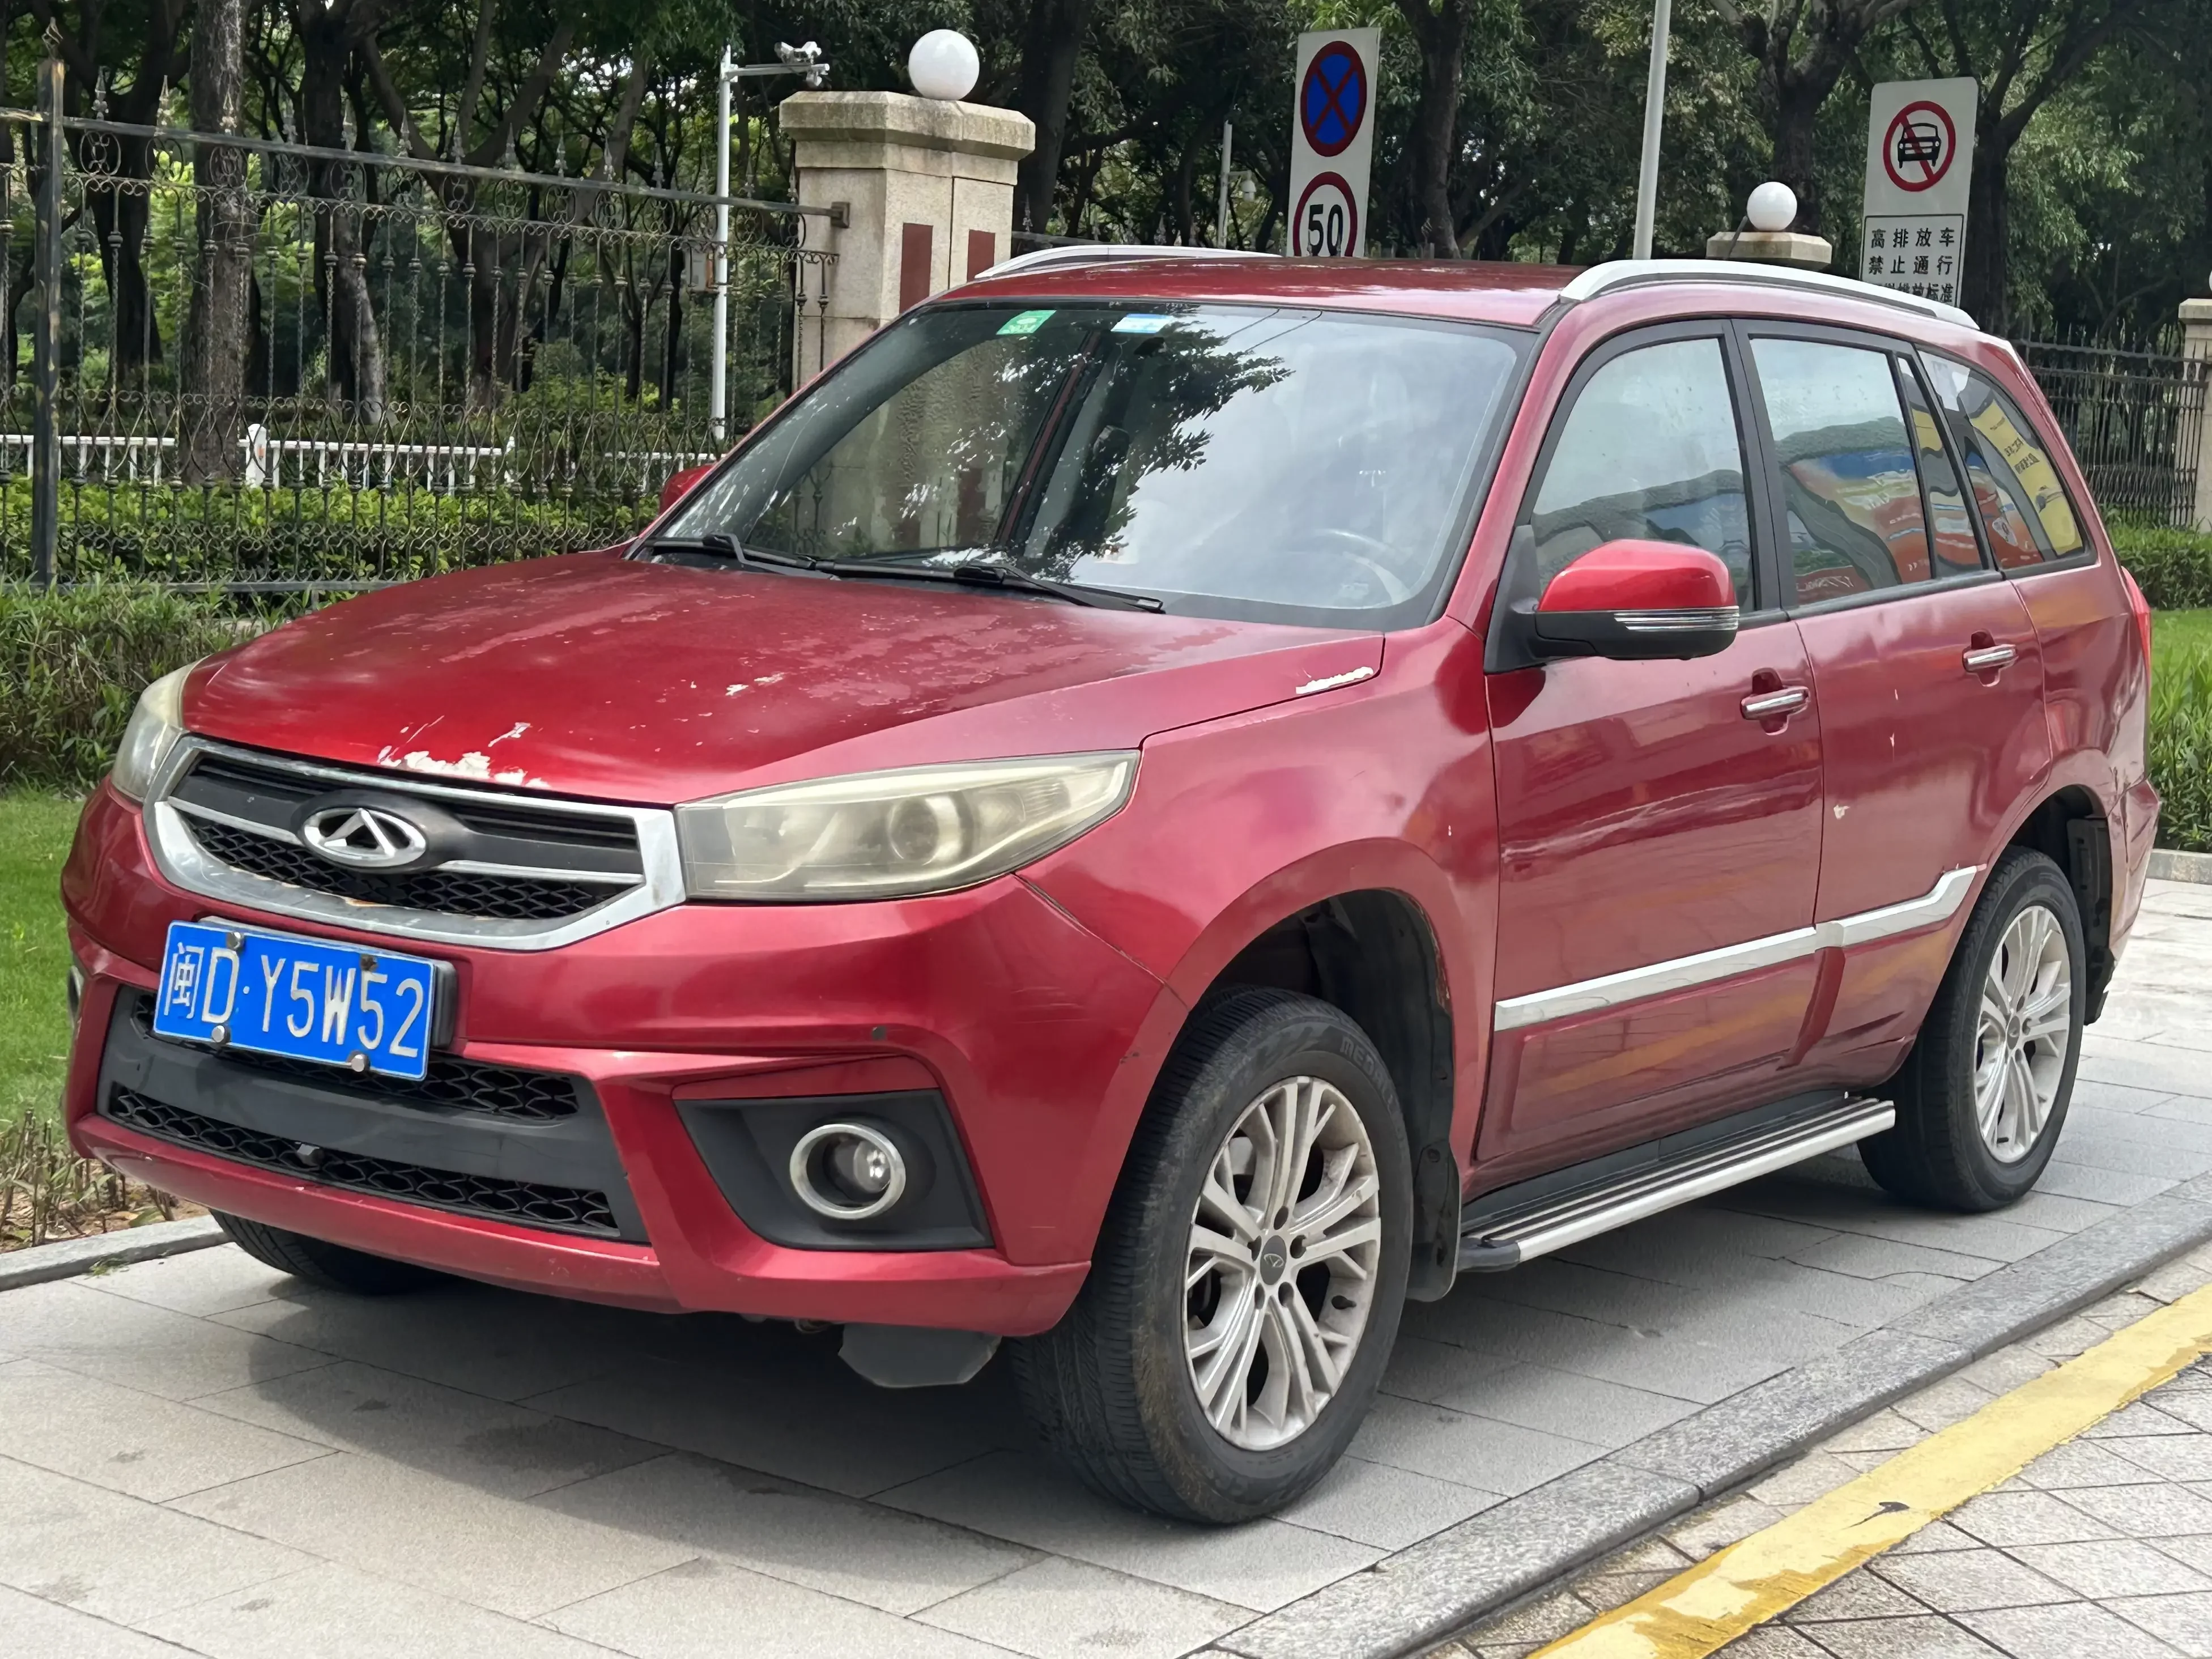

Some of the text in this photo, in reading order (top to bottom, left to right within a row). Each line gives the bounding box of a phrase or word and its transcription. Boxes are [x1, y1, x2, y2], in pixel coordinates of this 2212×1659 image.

[1308, 204, 1343, 256] 50
[1871, 227, 1955, 248] 高排放车
[1869, 255, 1953, 275] 禁止通行
